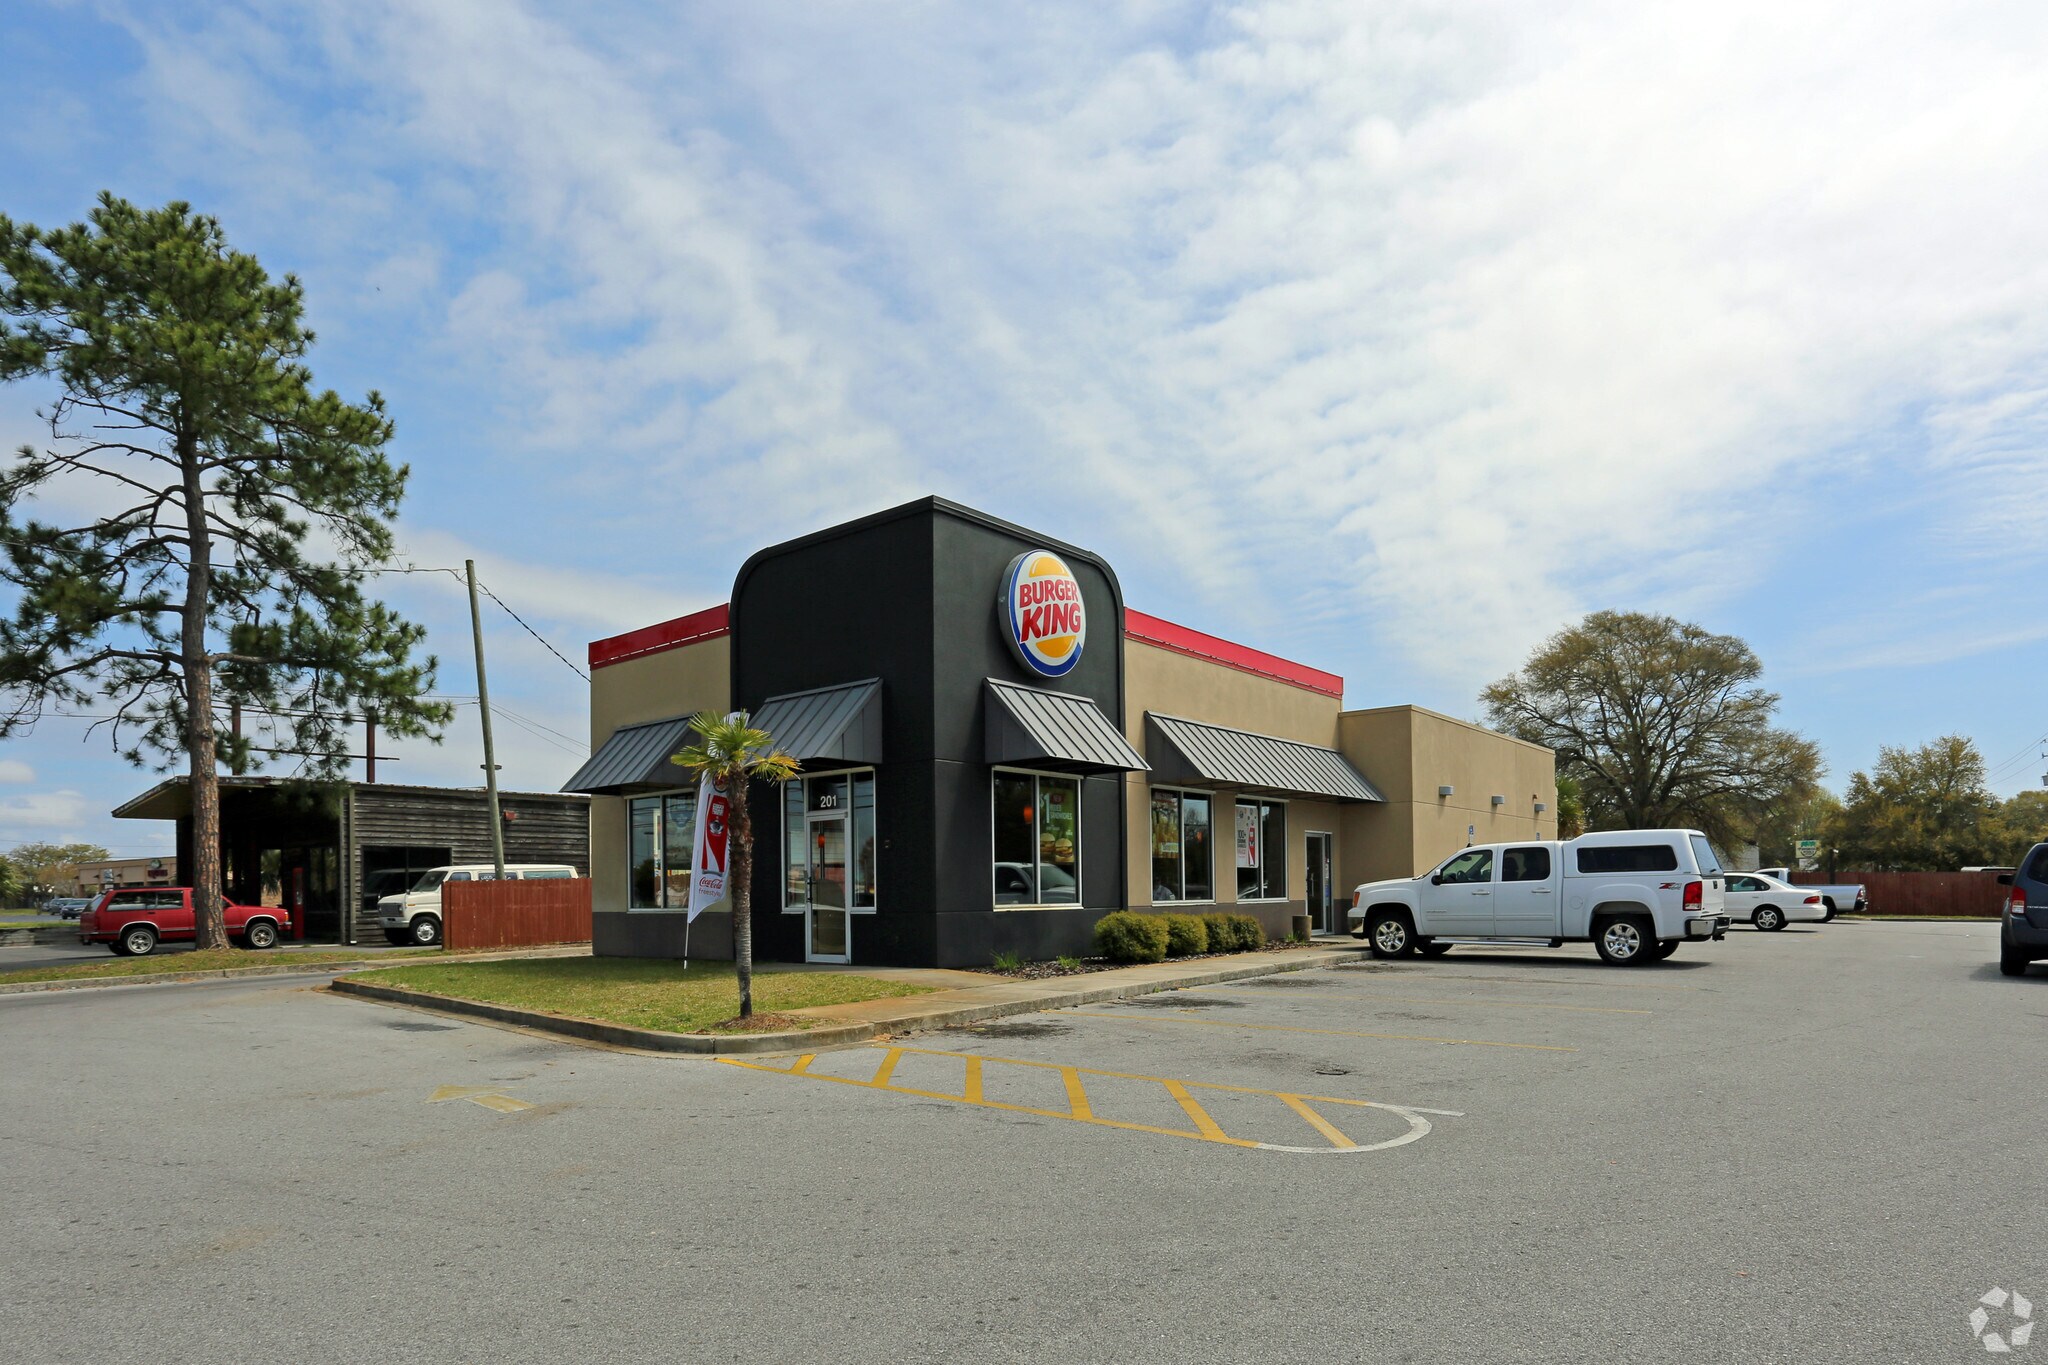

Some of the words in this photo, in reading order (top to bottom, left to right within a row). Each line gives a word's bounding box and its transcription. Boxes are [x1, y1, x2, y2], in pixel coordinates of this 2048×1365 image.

[1019, 579, 1078, 608] BURGER
[1021, 602, 1081, 643] KING
[820, 794, 837, 808] 201
